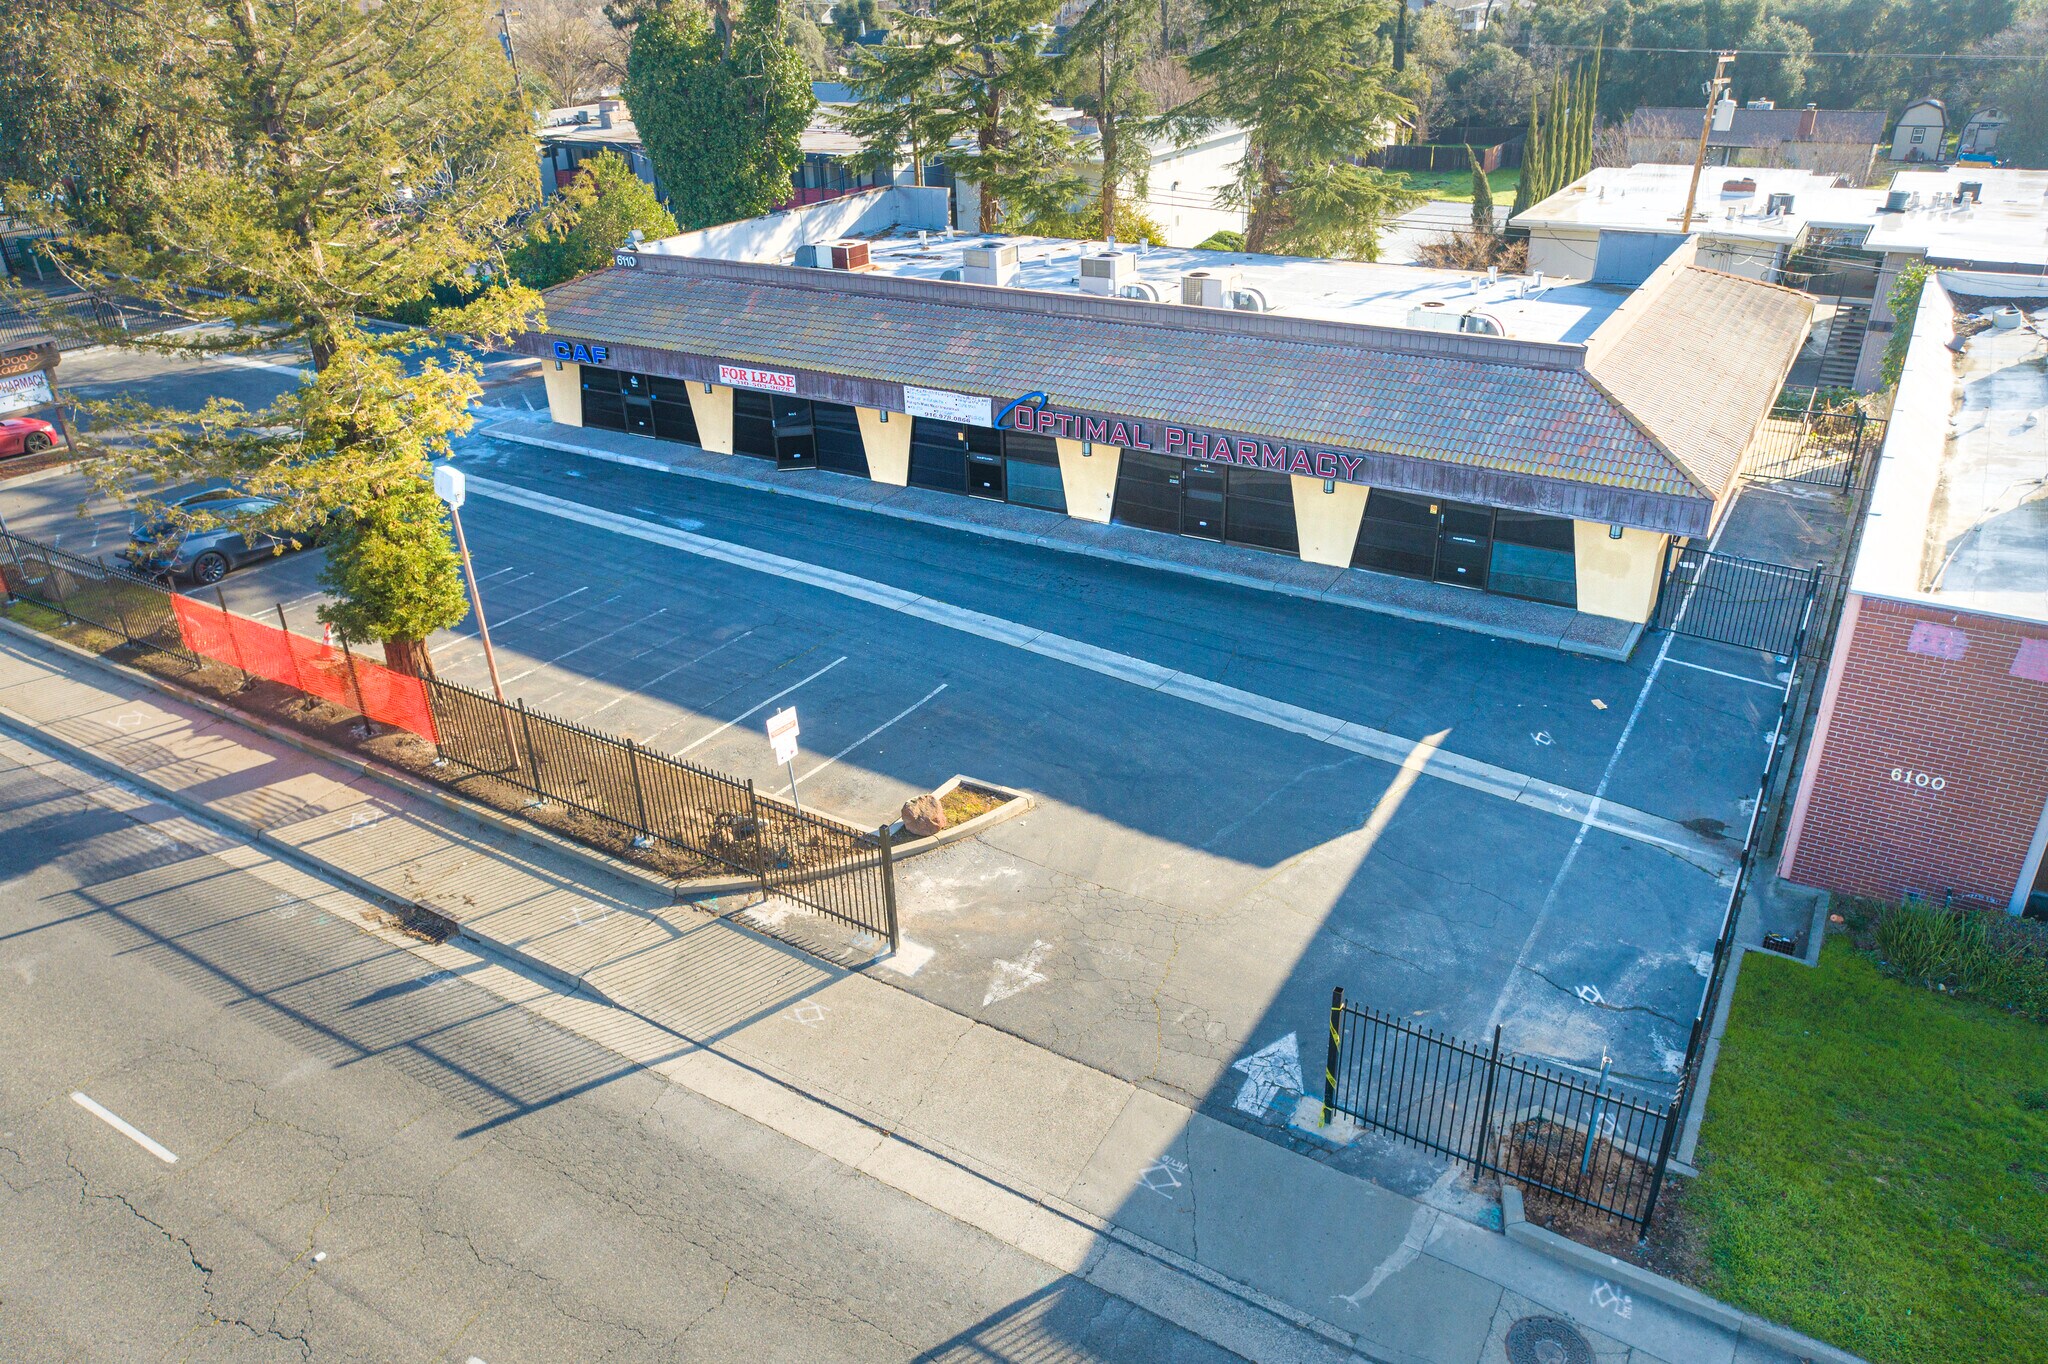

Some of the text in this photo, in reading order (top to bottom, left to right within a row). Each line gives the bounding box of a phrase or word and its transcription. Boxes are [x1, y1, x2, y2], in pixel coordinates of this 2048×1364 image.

[617, 255, 635, 267] 6110
[553, 341, 607, 364] CAF
[721, 367, 795, 388] FOR LEASE
[1014, 405, 1364, 481] OPTIMAL PHARMACY
[1891, 768, 1945, 790] 6100
